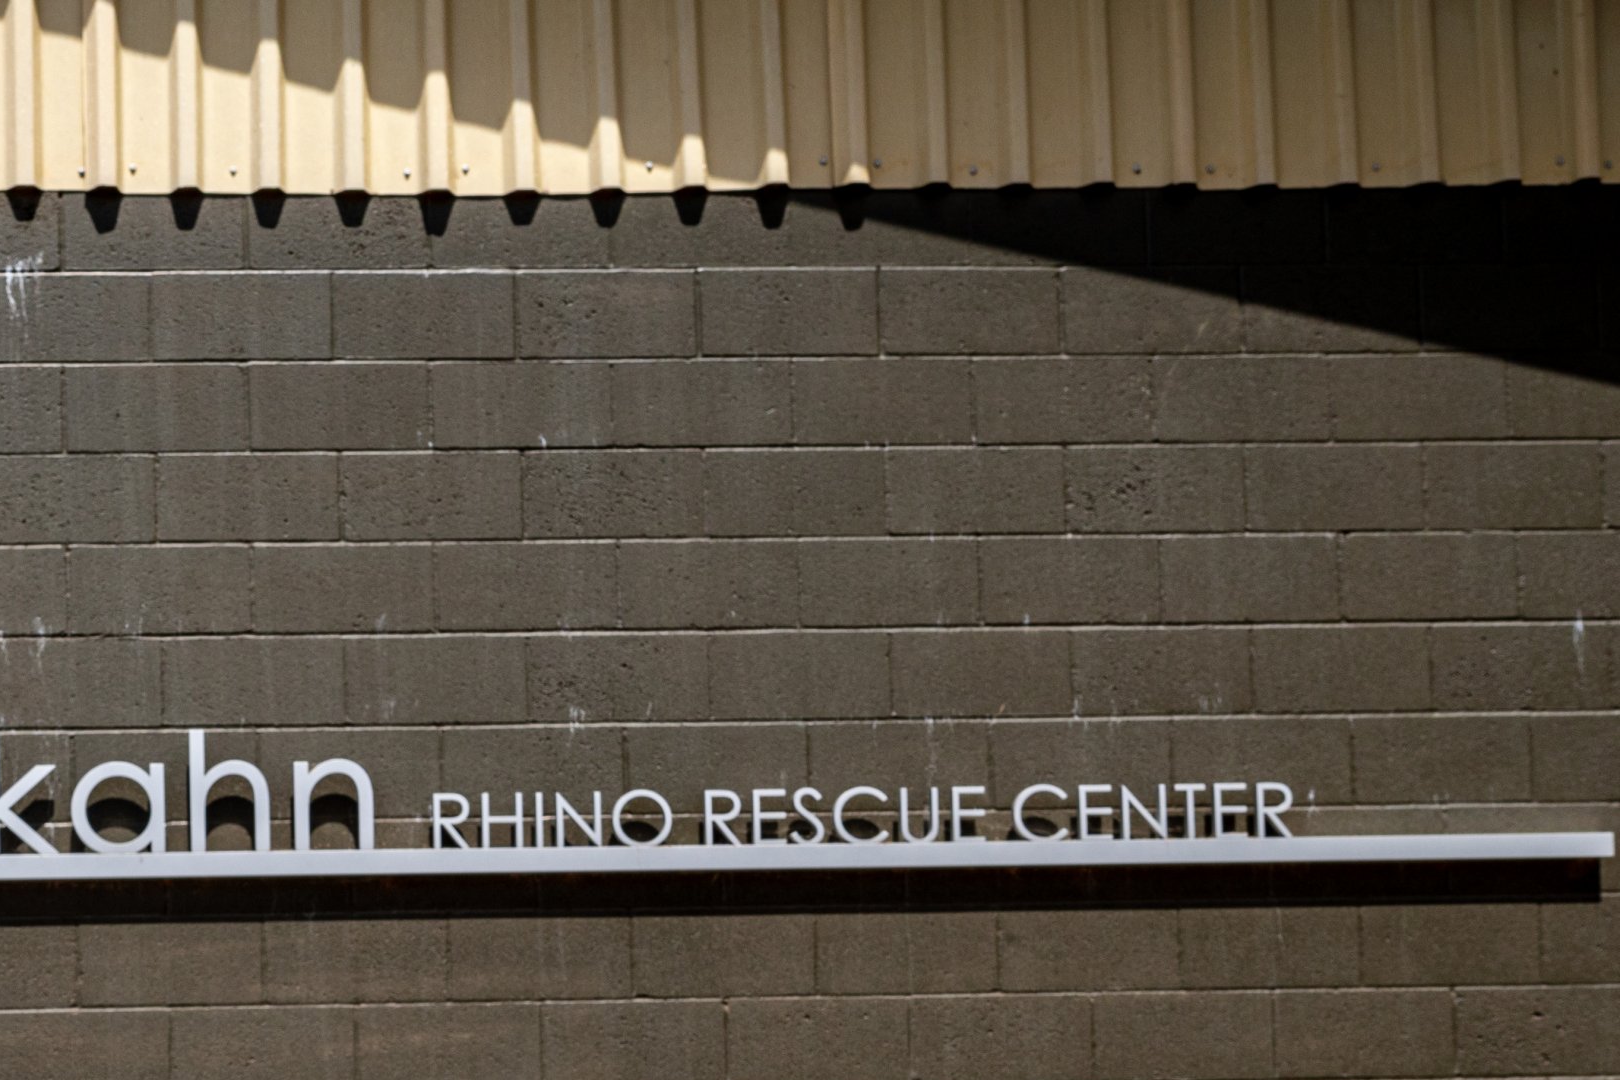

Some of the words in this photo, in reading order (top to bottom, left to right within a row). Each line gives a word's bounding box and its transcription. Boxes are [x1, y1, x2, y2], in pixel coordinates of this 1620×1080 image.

[430, 788, 674, 848] RHINO
[703, 785, 986, 846] RESCUE
[1012, 781, 1294, 841] CENTER
